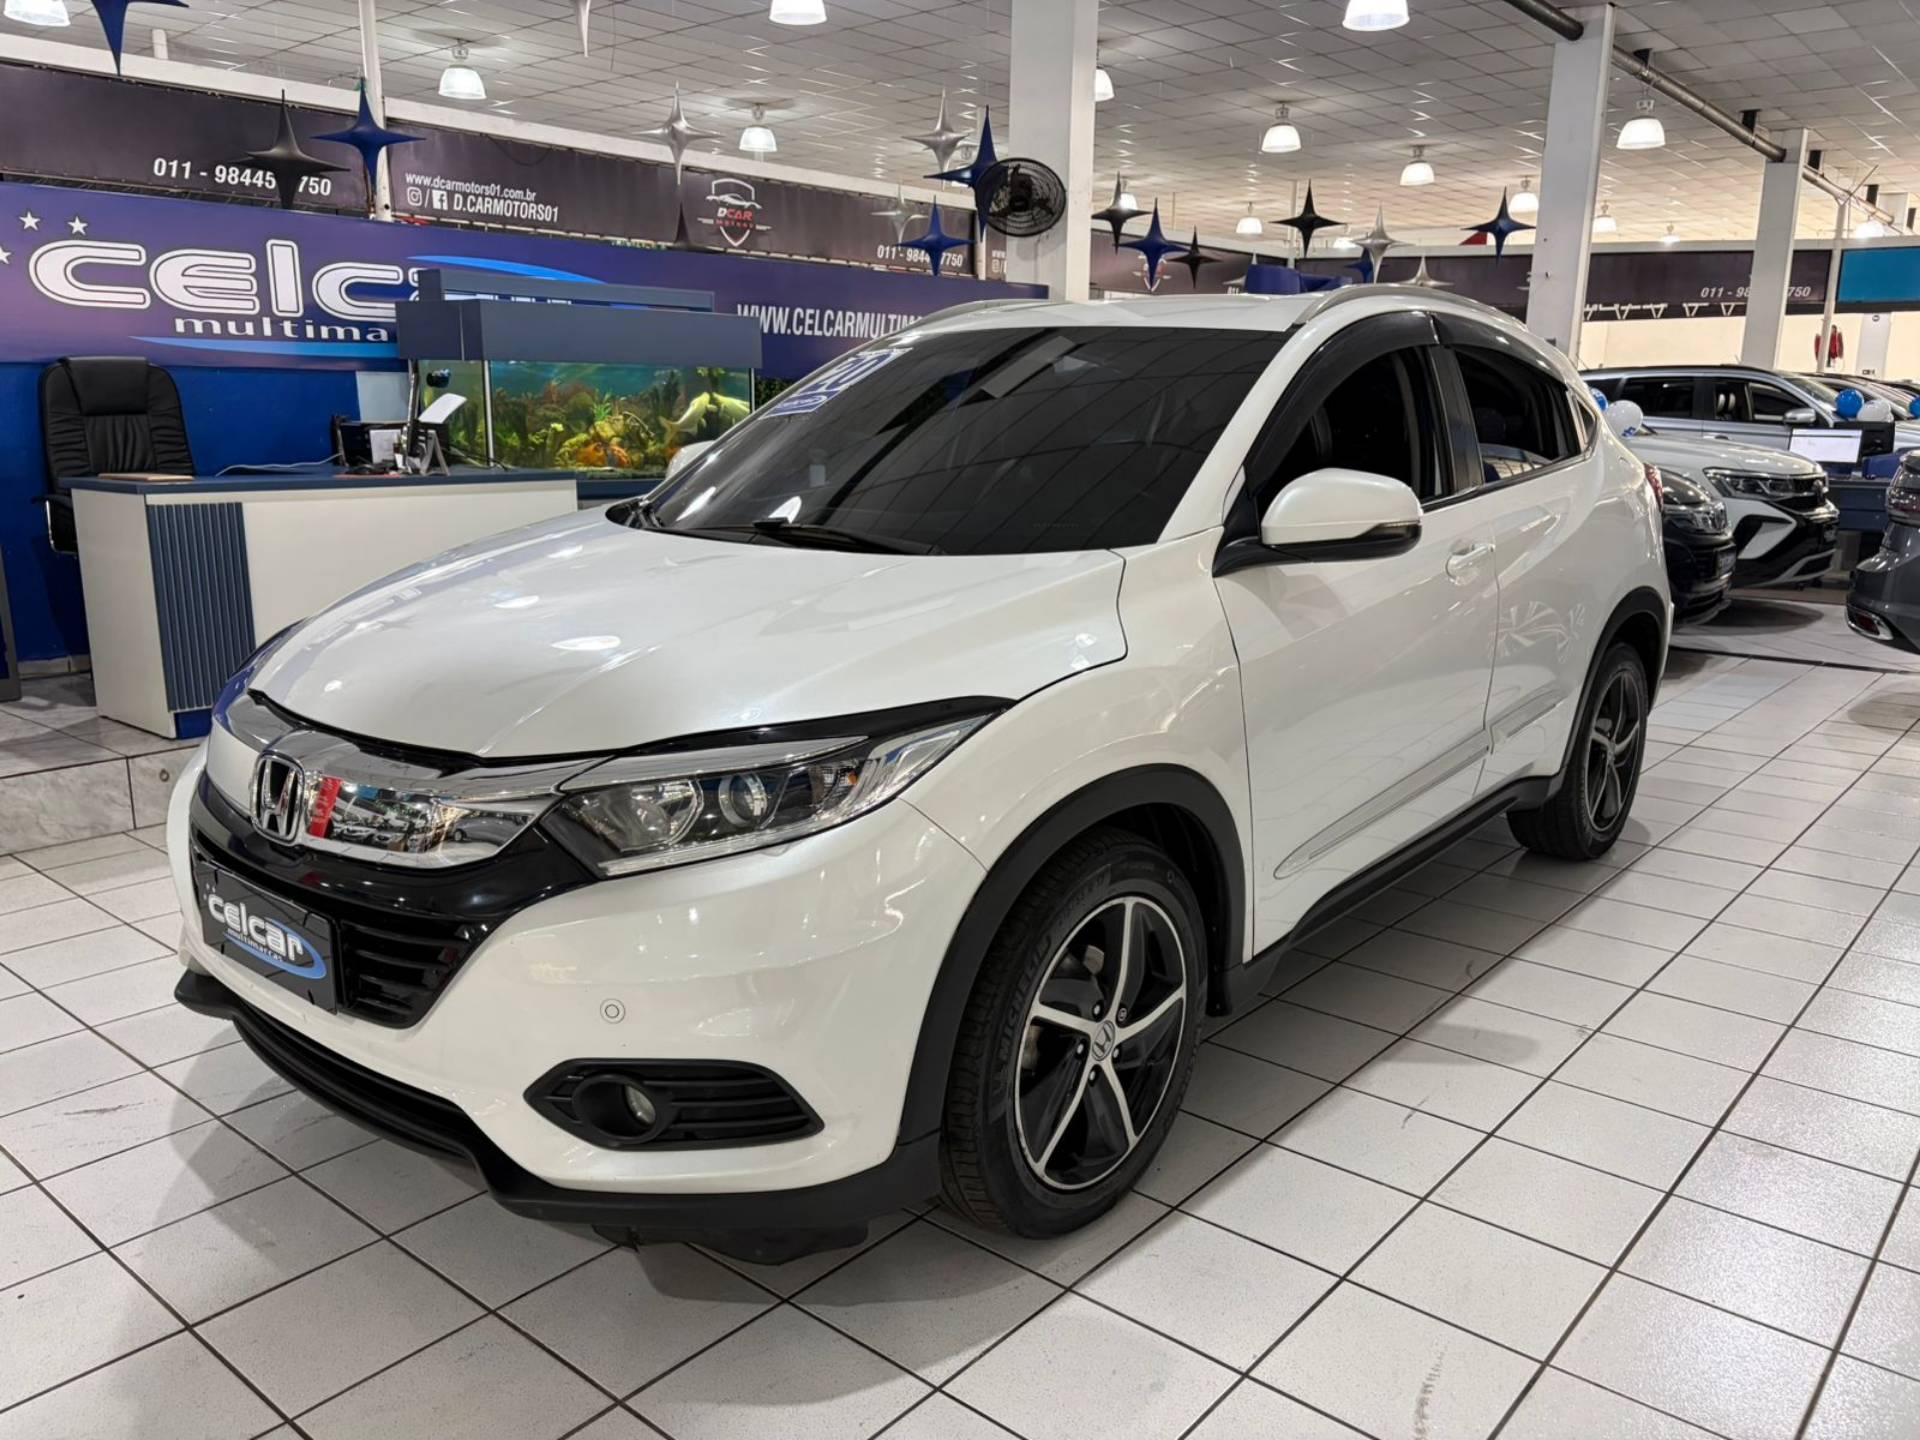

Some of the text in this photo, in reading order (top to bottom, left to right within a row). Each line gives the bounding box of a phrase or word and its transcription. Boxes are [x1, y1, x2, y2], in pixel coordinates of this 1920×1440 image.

[153, 157, 192, 180] 011
[405, 172, 537, 201] www.dcarmotors01.com.br
[452, 193, 559, 223] D.CARMOTORS01
[877, 245, 896, 260] 011
[28, 238, 420, 323] celc
[1700, 287, 1724, 298] 011
[174, 316, 389, 342] multima
[207, 893, 304, 961] celcar
